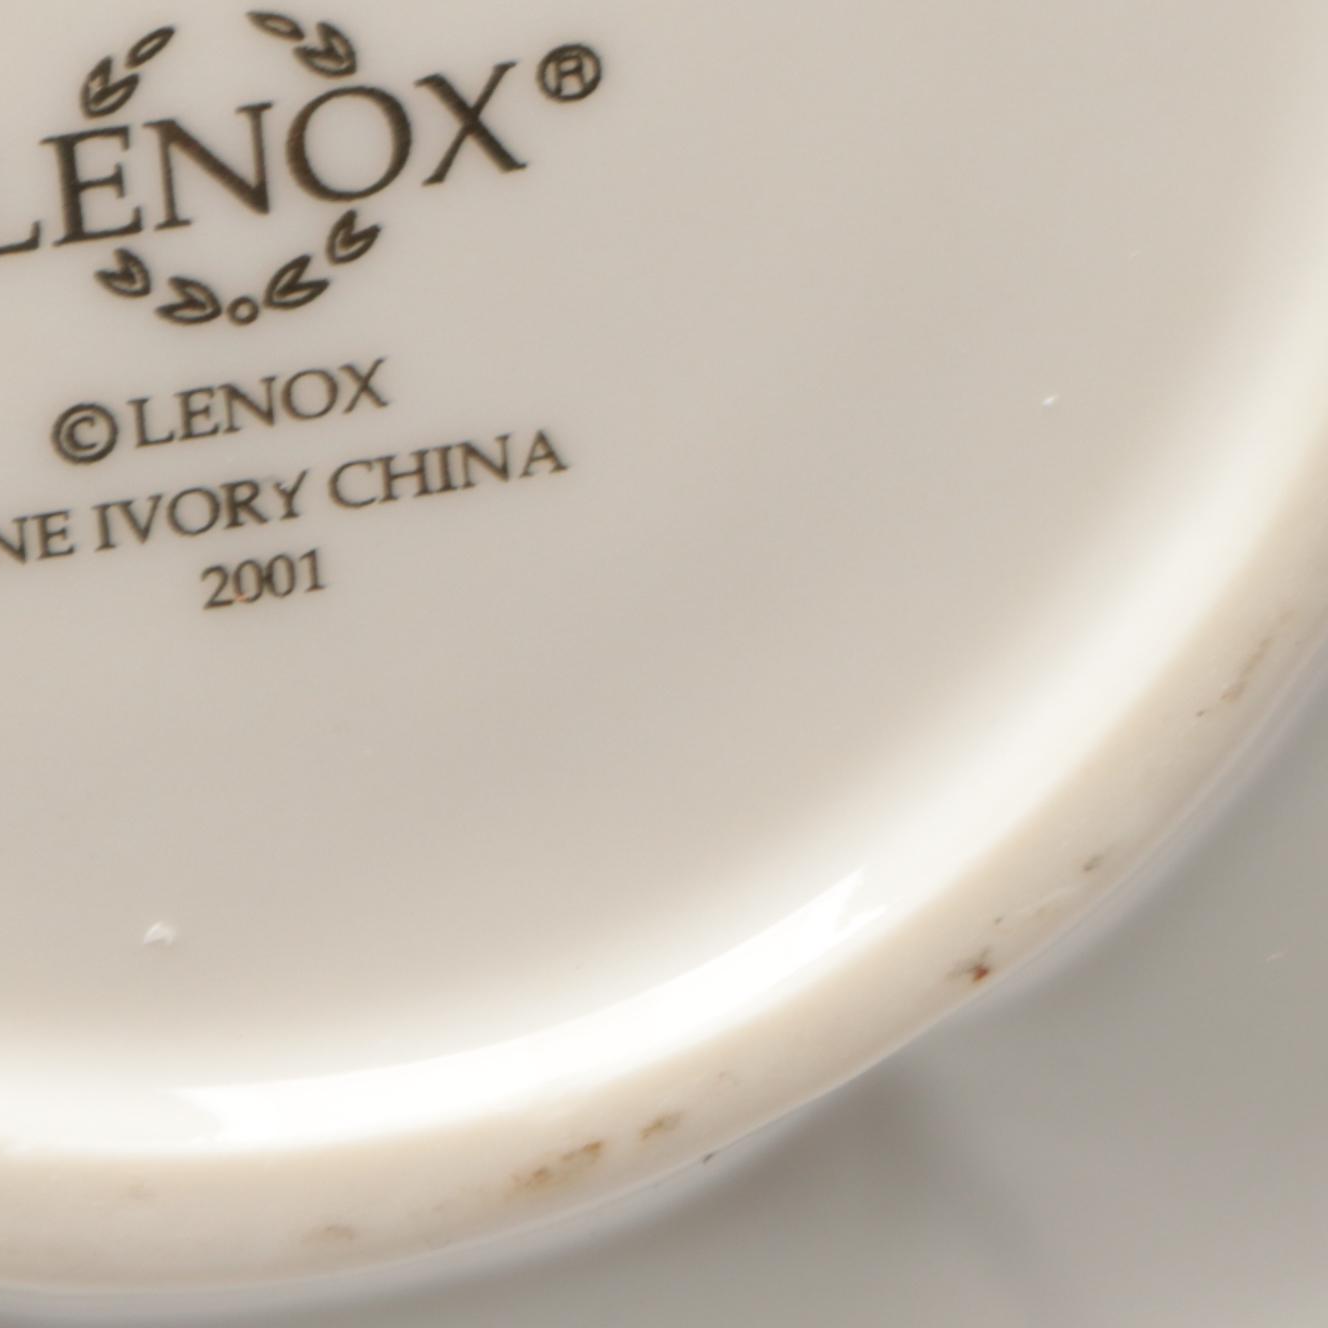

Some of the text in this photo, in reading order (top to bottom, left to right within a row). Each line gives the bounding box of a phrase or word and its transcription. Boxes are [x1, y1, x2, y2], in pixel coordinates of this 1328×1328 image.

[95, 470, 307, 551] IVORY
[328, 429, 569, 509] CHINA
[202, 548, 325, 610] 2001
